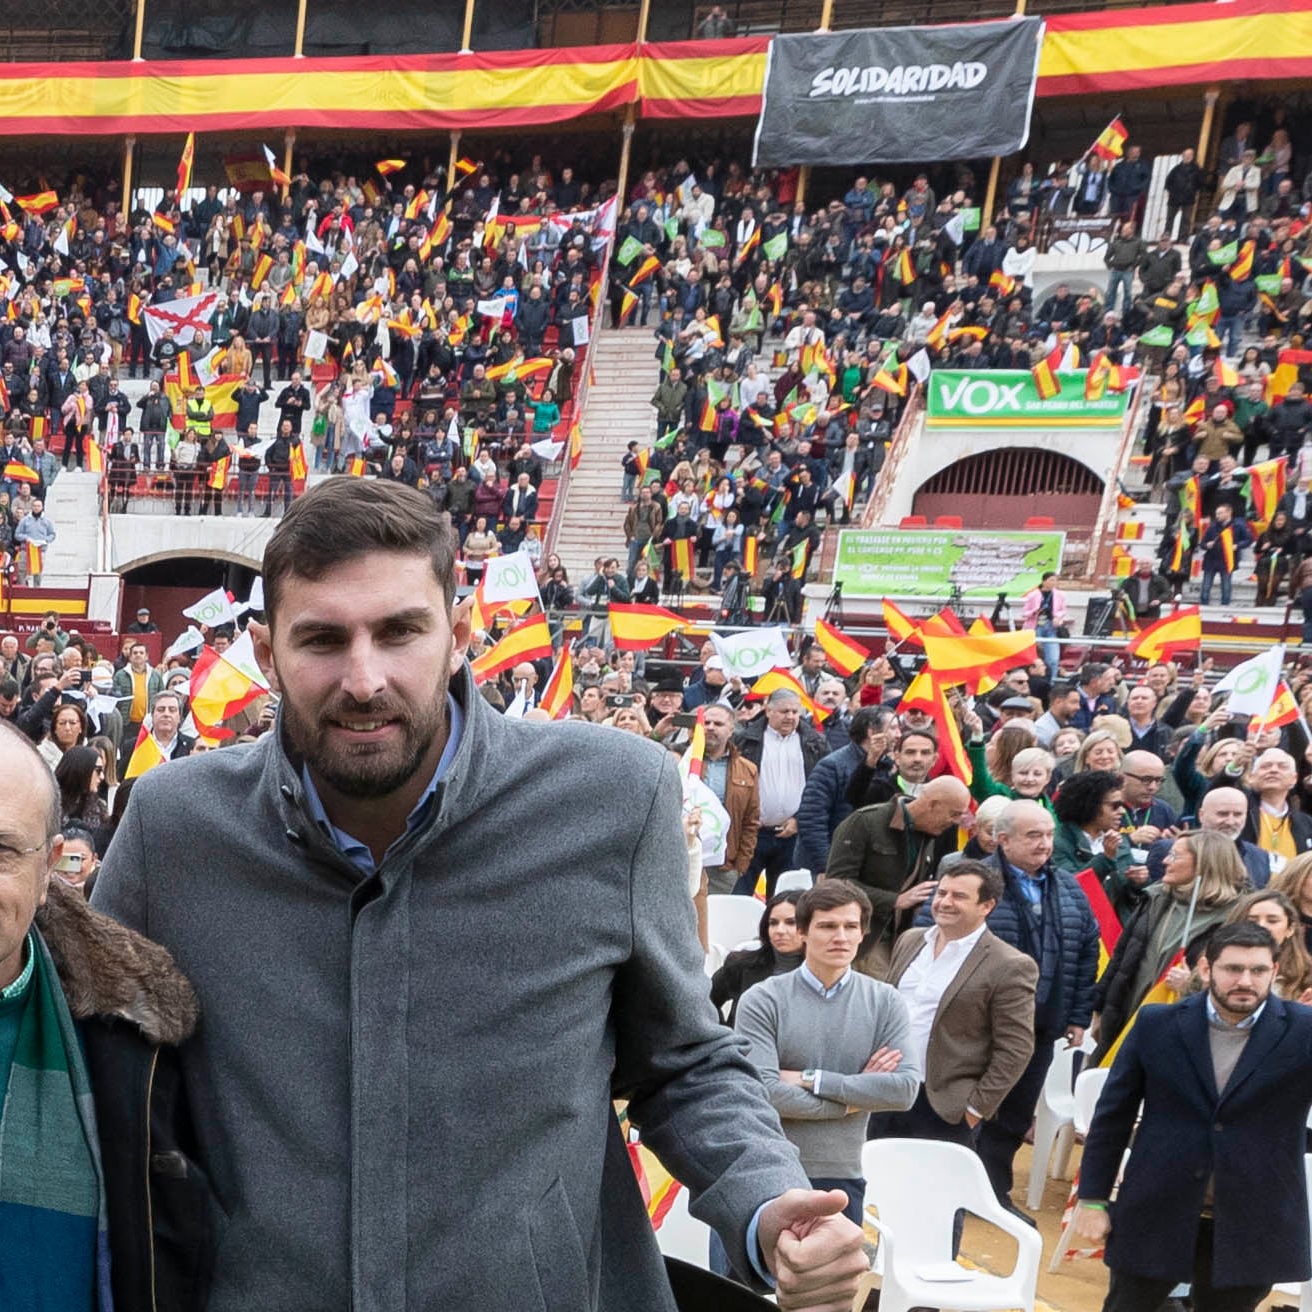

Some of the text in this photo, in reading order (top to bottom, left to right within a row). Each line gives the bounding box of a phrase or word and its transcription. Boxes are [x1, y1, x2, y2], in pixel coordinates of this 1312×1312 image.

[809, 61, 988, 97] SOLIDARIDAD
[940, 376, 1025, 414] VOX
[725, 642, 776, 668] VOX
